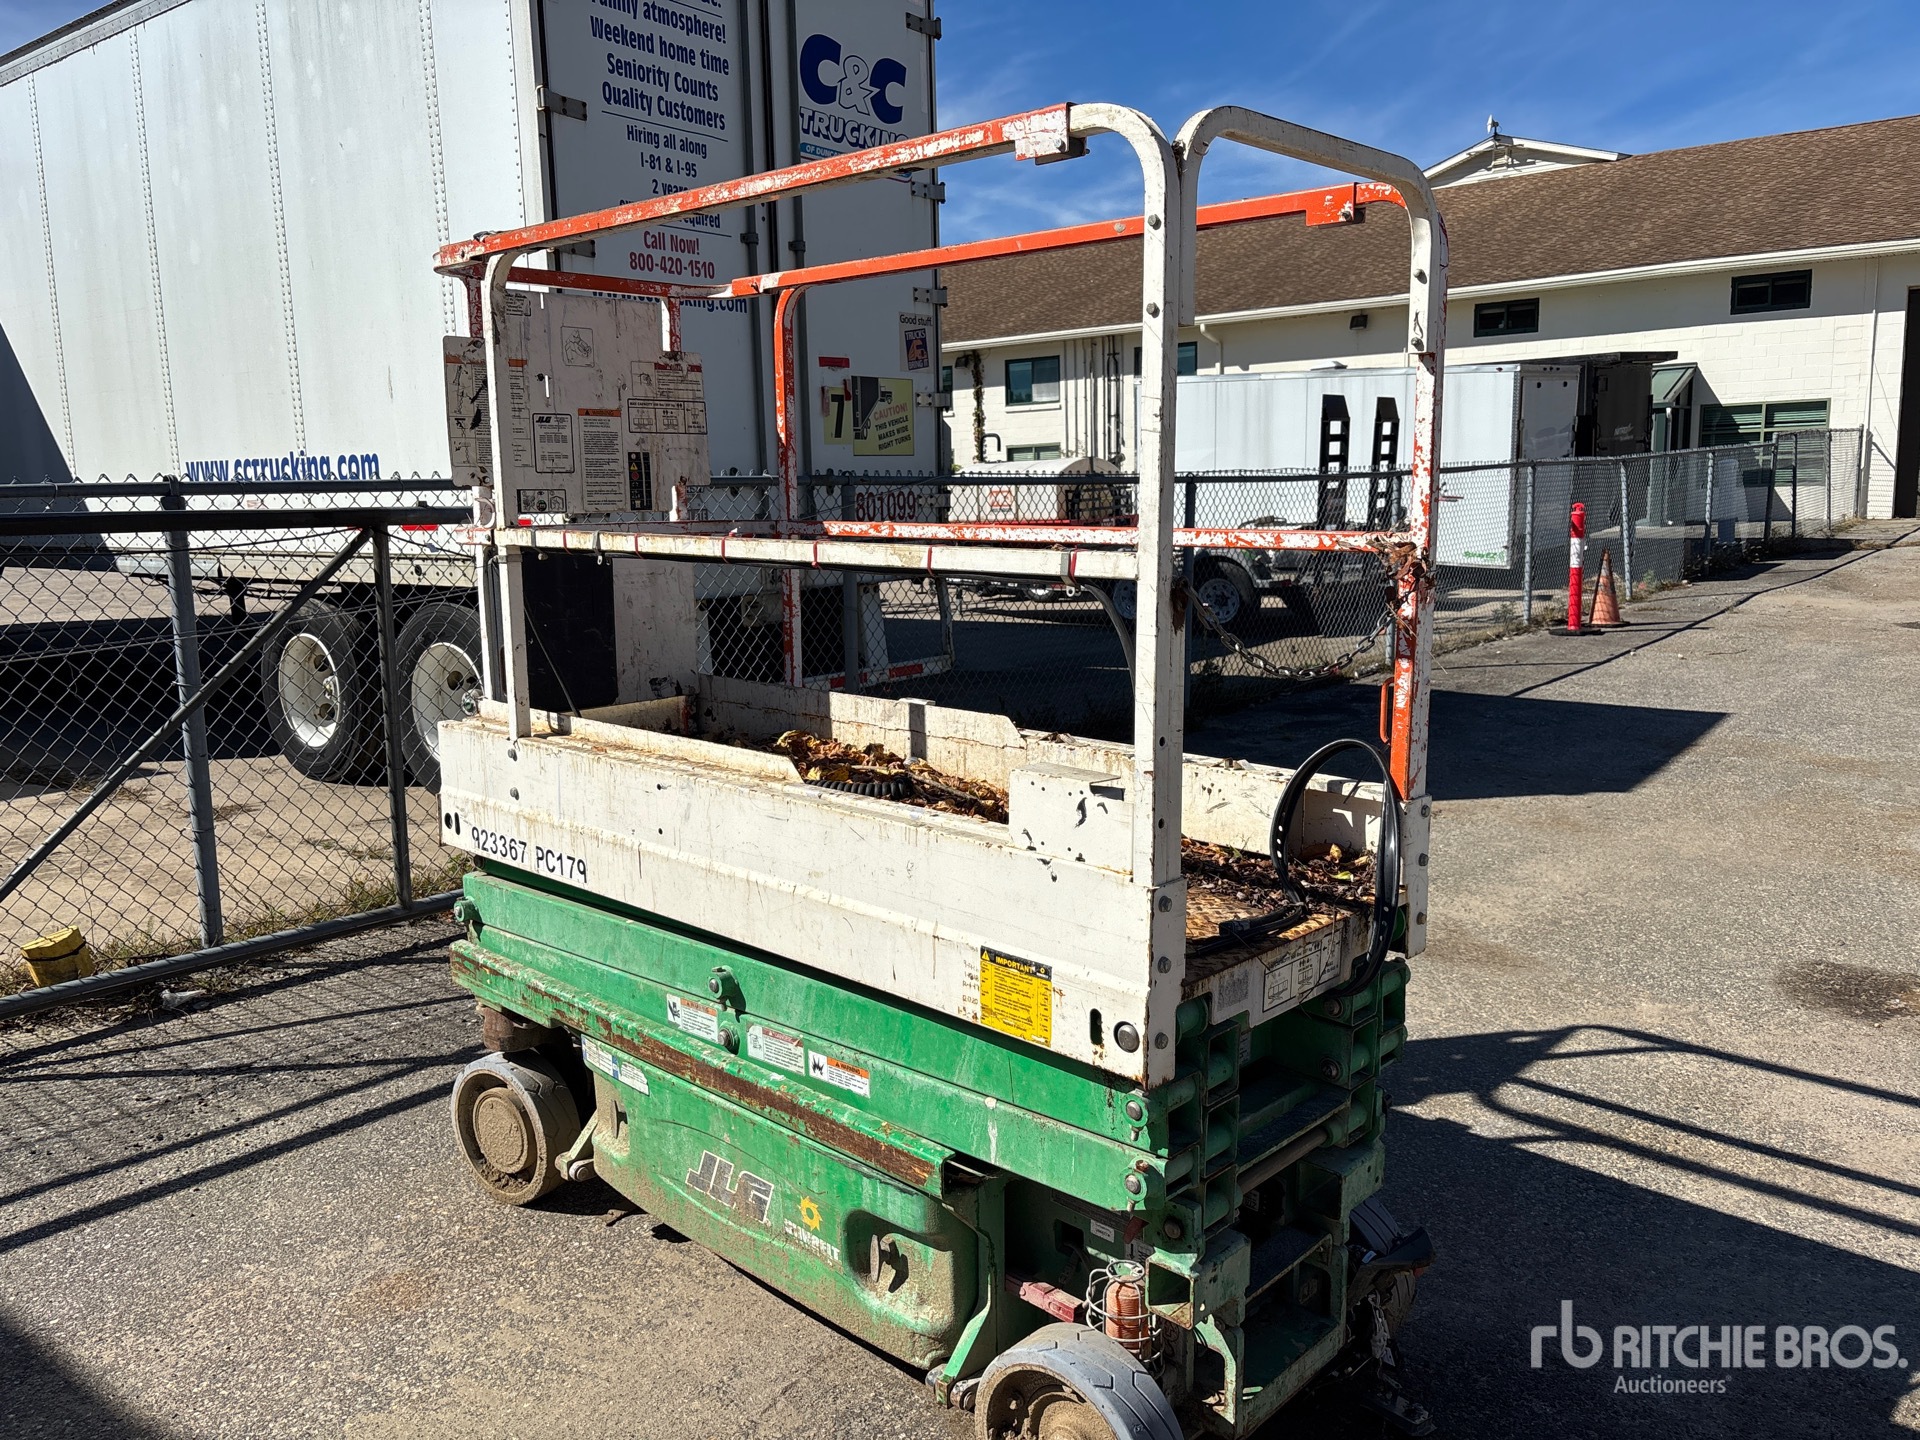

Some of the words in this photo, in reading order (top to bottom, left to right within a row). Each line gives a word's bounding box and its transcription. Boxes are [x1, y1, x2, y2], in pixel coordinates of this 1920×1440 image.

[643, 1, 726, 44] atmosphere!
[590, 15, 655, 54] Weekend
[659, 35, 696, 66] home
[700, 48, 730, 75] time
[607, 52, 670, 92] Seniority
[674, 71, 719, 101] Counts
[800, 33, 907, 124] C&C
[602, 81, 652, 116] Quality
[657, 95, 726, 131] Customers
[627, 124, 660, 149] Hiring
[663, 133, 677, 150] all
[680, 136, 707, 159] along
[800, 107, 909, 148] TRUCKIN
[640, 151, 662, 171] I-81
[665, 157, 674, 174] &
[677, 159, 697, 178] I-95
[652, 178, 659, 195] 2
[643, 230, 666, 251] Call
[670, 234, 700, 255] Now!
[629, 251, 715, 280] 800-420-1510
[900, 314, 916, 325] Good
[831, 394, 844, 438] 7
[874, 402, 908, 420] CAUTION!
[875, 421, 887, 431] THIS
[888, 415, 909, 427] VEHICLE
[878, 429, 895, 440] MAKES
[896, 425, 909, 434] WIDE
[879, 441, 894, 451] RIGHT
[895, 434, 911, 445] TURNS
[856, 491, 916, 522] 801099
[472, 826, 527, 863] 923367
[536, 845, 587, 883] PC179
[995, 955, 1035, 974] IMPORTANT
[685, 1150, 775, 1225] JLG
